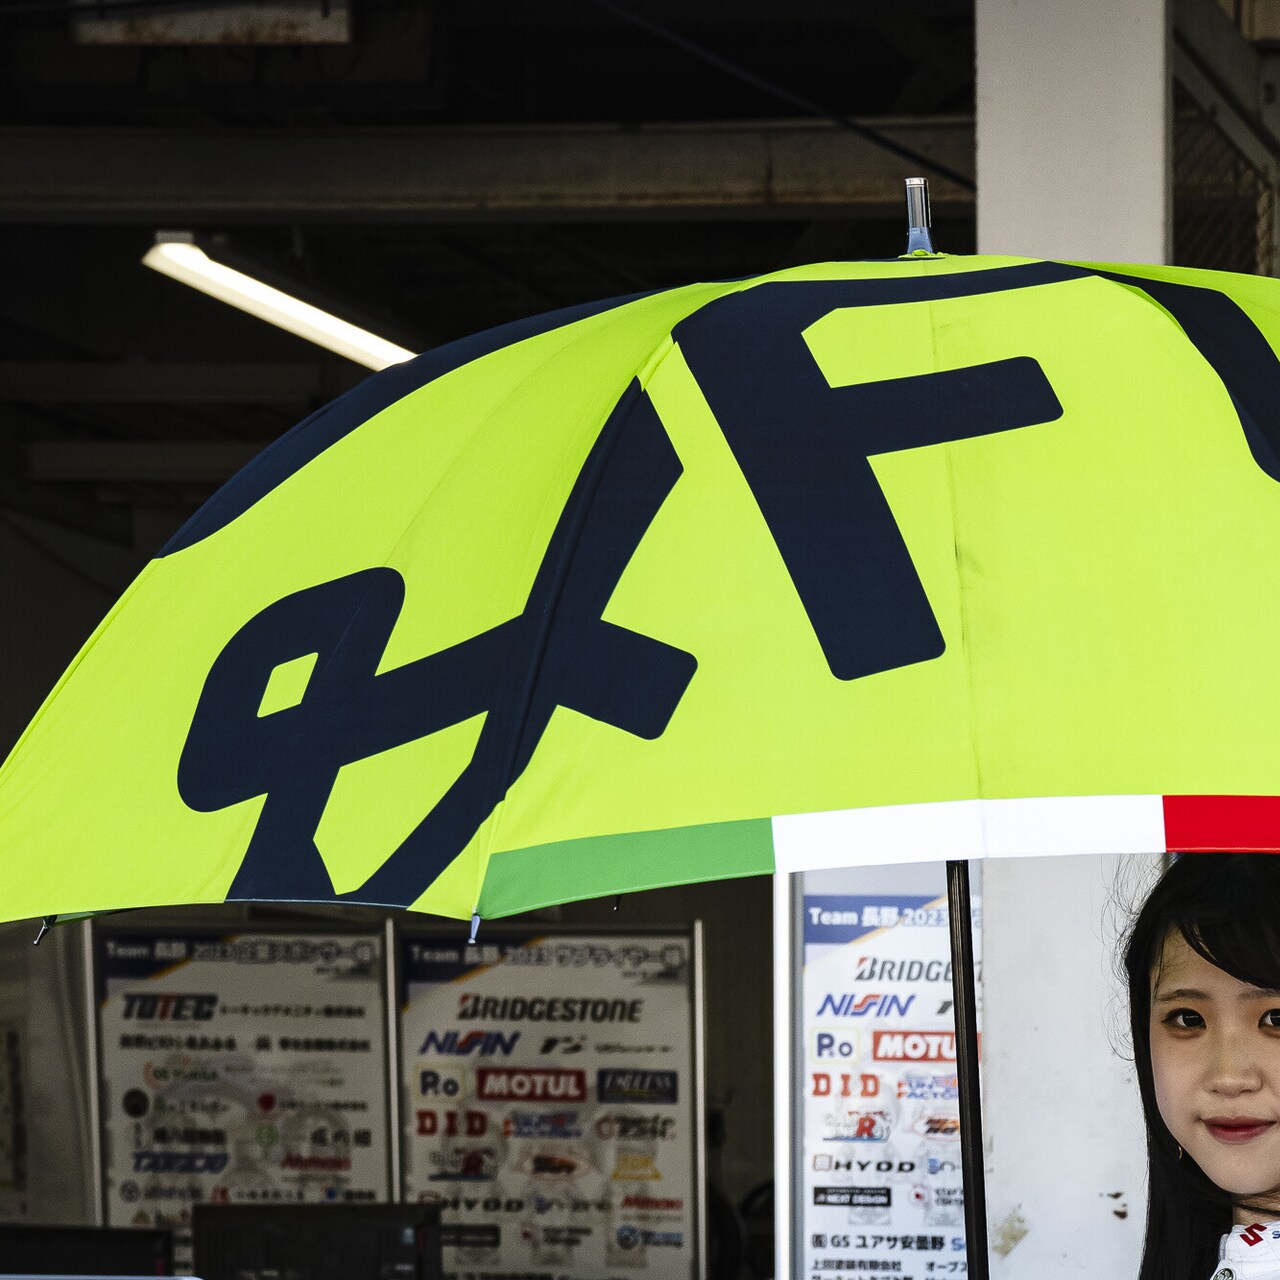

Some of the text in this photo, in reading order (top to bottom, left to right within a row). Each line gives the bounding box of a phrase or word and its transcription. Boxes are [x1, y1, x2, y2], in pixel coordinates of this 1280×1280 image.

[809, 907, 858, 925] Team
[457, 993, 643, 1023] BRIDGESTONE
[876, 1034, 956, 1060] MOTU
[482, 1074, 582, 1097] MOTUL
[834, 1160, 916, 1173] HYOD
